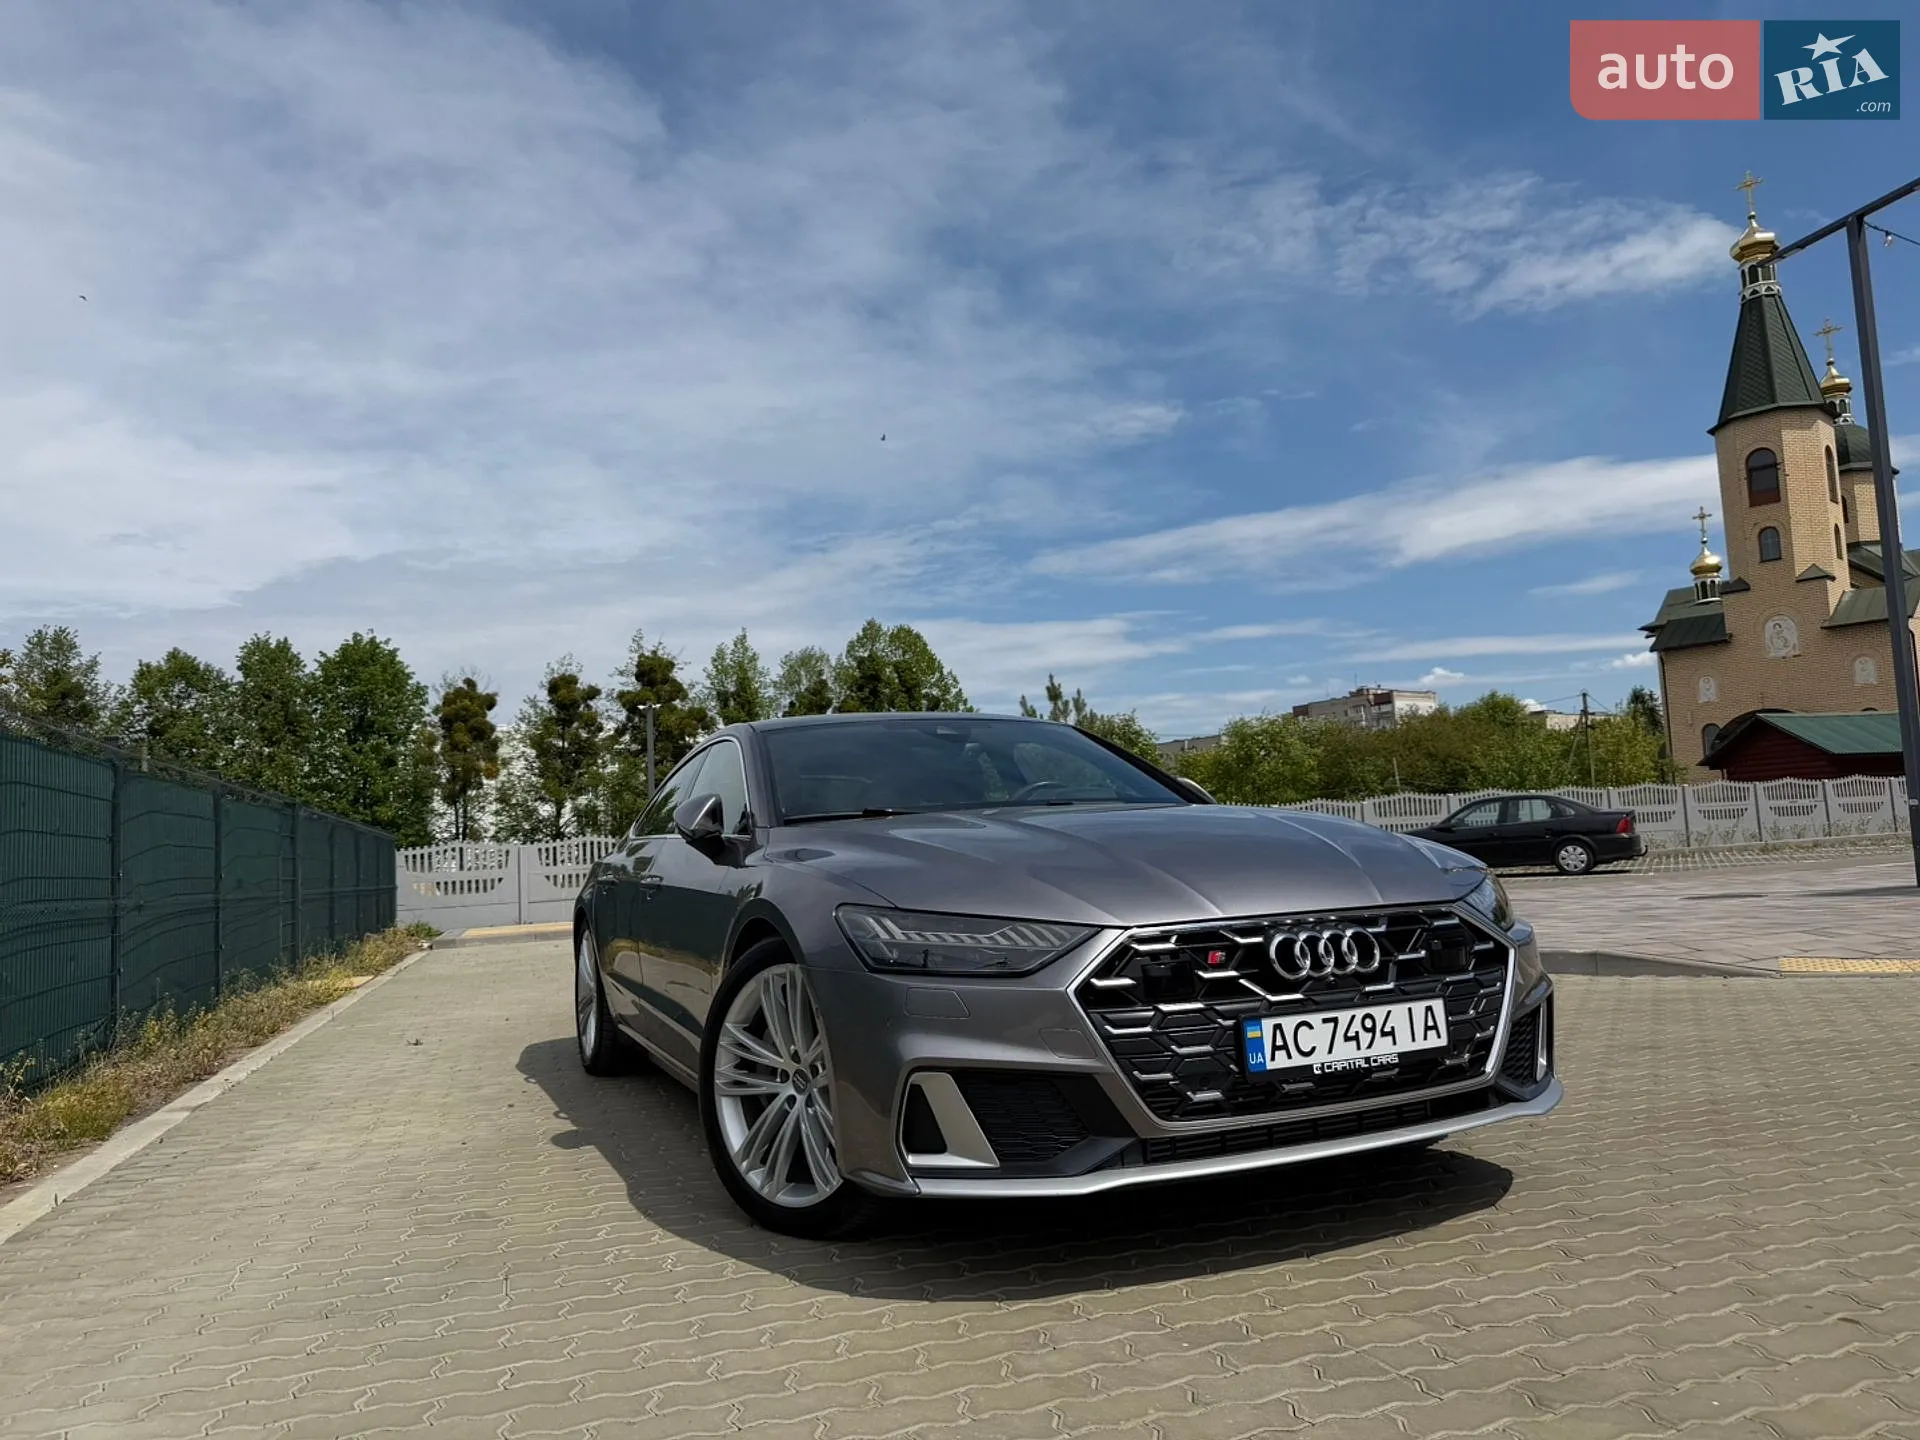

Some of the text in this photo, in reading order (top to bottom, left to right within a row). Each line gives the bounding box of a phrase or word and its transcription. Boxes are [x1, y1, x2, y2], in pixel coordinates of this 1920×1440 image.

[1270, 1004, 1442, 1062] AC 7494 IA
[1249, 1052, 1265, 1065] UA
[1323, 1053, 1399, 1073] CAPITAL CARS
